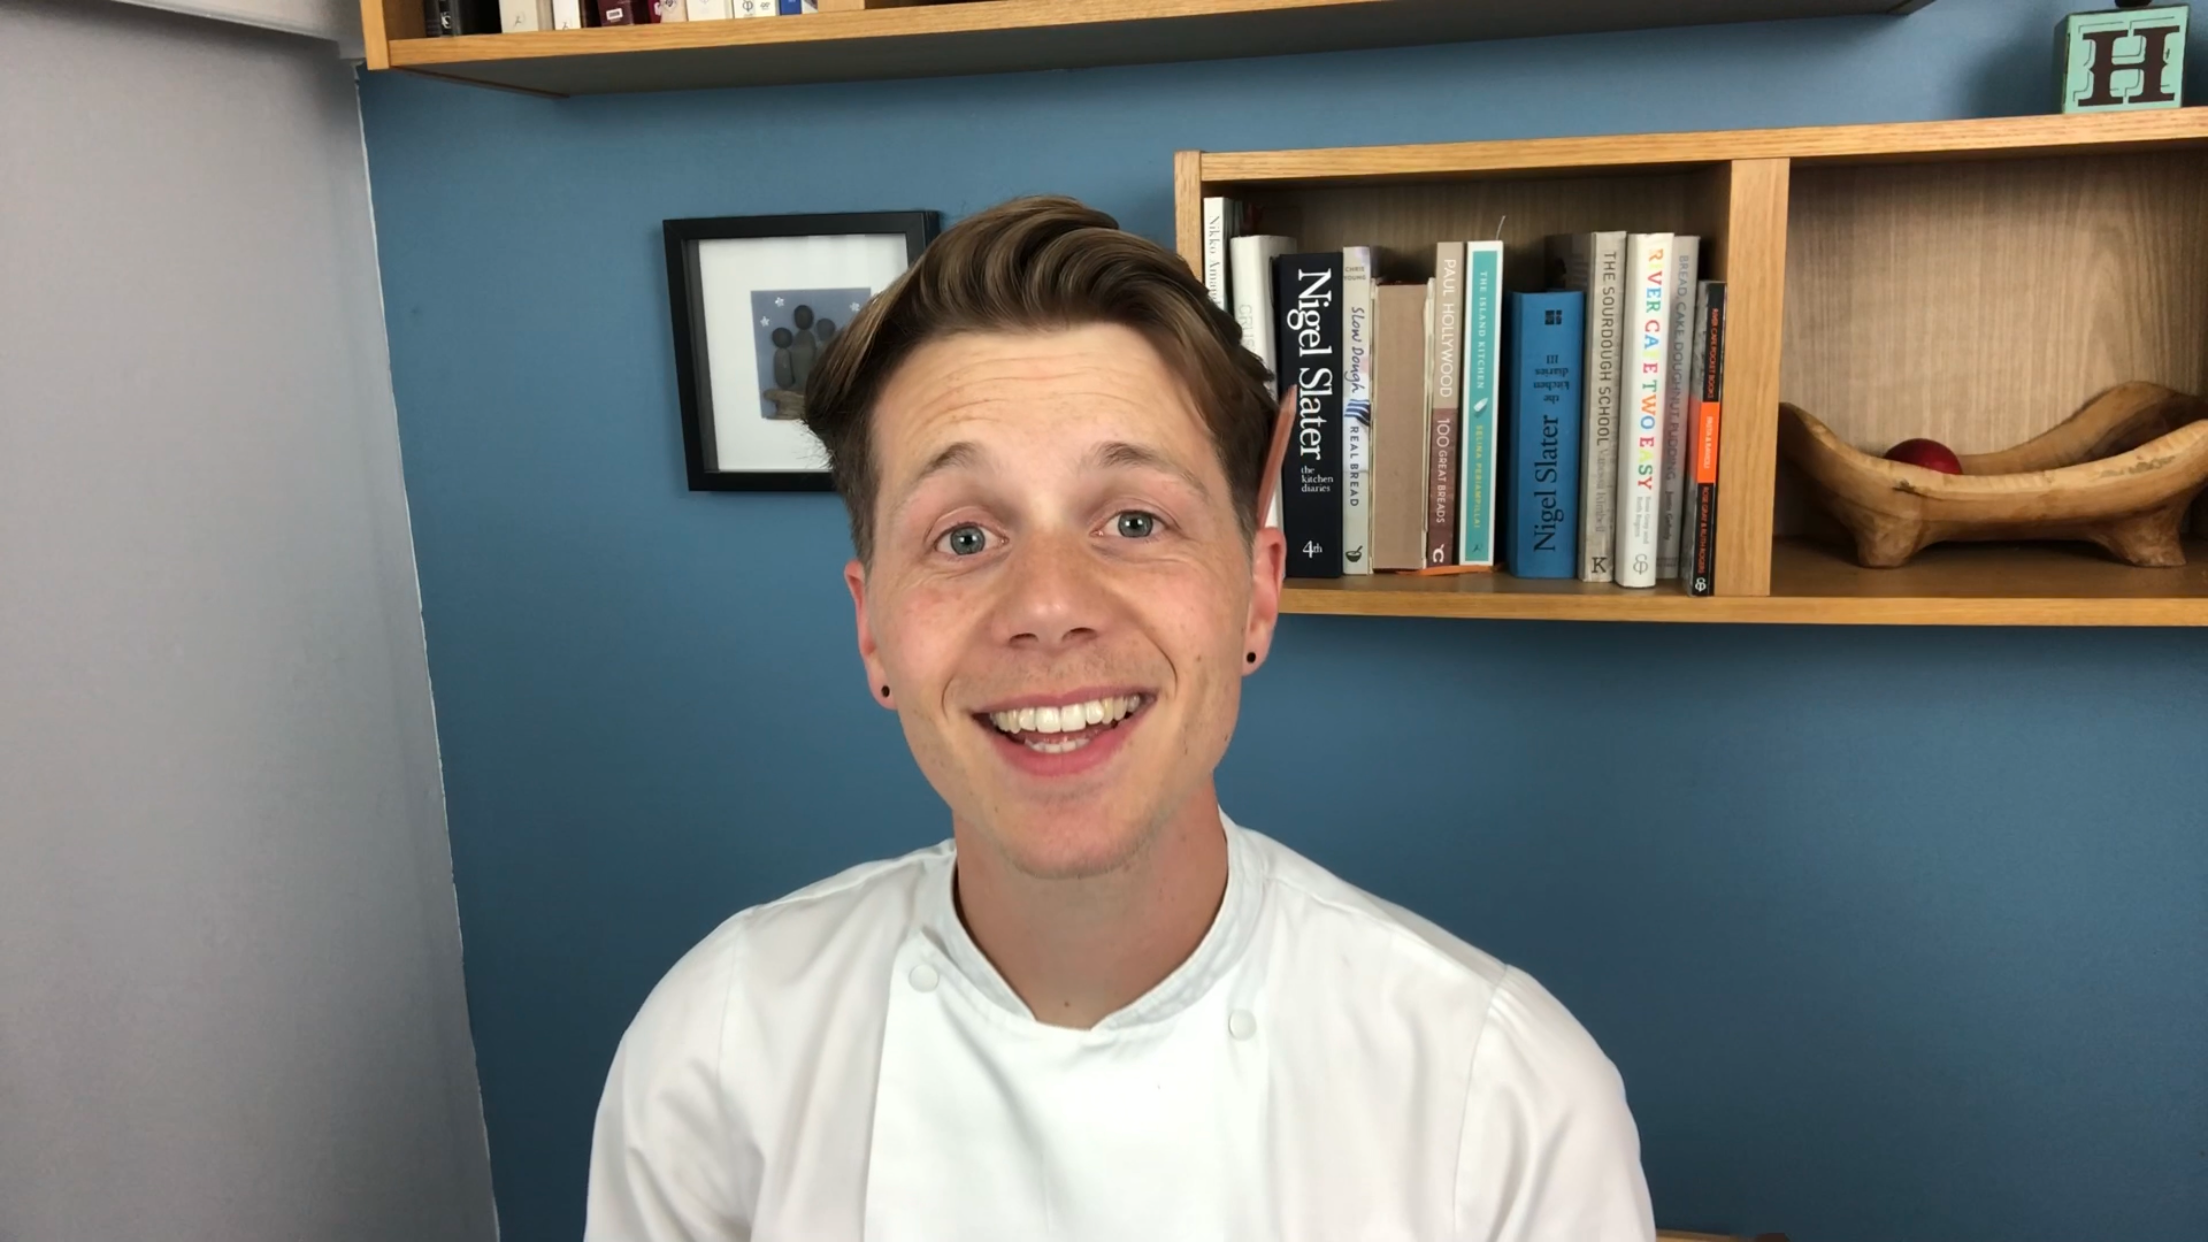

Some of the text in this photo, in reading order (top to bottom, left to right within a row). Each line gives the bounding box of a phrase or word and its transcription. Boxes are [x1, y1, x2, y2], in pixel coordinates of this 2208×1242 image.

[2078, 25, 2180, 106] H
[1209, 215, 1221, 254] Nikko
[1239, 304, 1256, 352] CRUS
[1344, 307, 1365, 393] Slow Dough
[1440, 259, 1457, 398] PAUL HOLLYWOOD
[1476, 271, 1488, 389] THE ISLAND KITCHEN
[1597, 251, 1616, 446] THE SOURDOUGH SCHOOL
[1286, 268, 1333, 460] Nigel Slater
[1641, 380, 1657, 430] TWO
[1301, 465, 1315, 474] the
[1350, 426, 1359, 507] REAL BREAD
[1475, 425, 1483, 459] SELINA
[1637, 436, 1655, 490] EASY
[1666, 422, 1680, 481] PUDDING
[1301, 475, 1334, 483] kitchen
[1301, 484, 1331, 492] diaries
[1436, 418, 1450, 523] 100 GREAT BREADS
[1534, 414, 1564, 552] Nigel Slater
[1303, 540, 1323, 558] 4th
[1591, 557, 1606, 573] K
